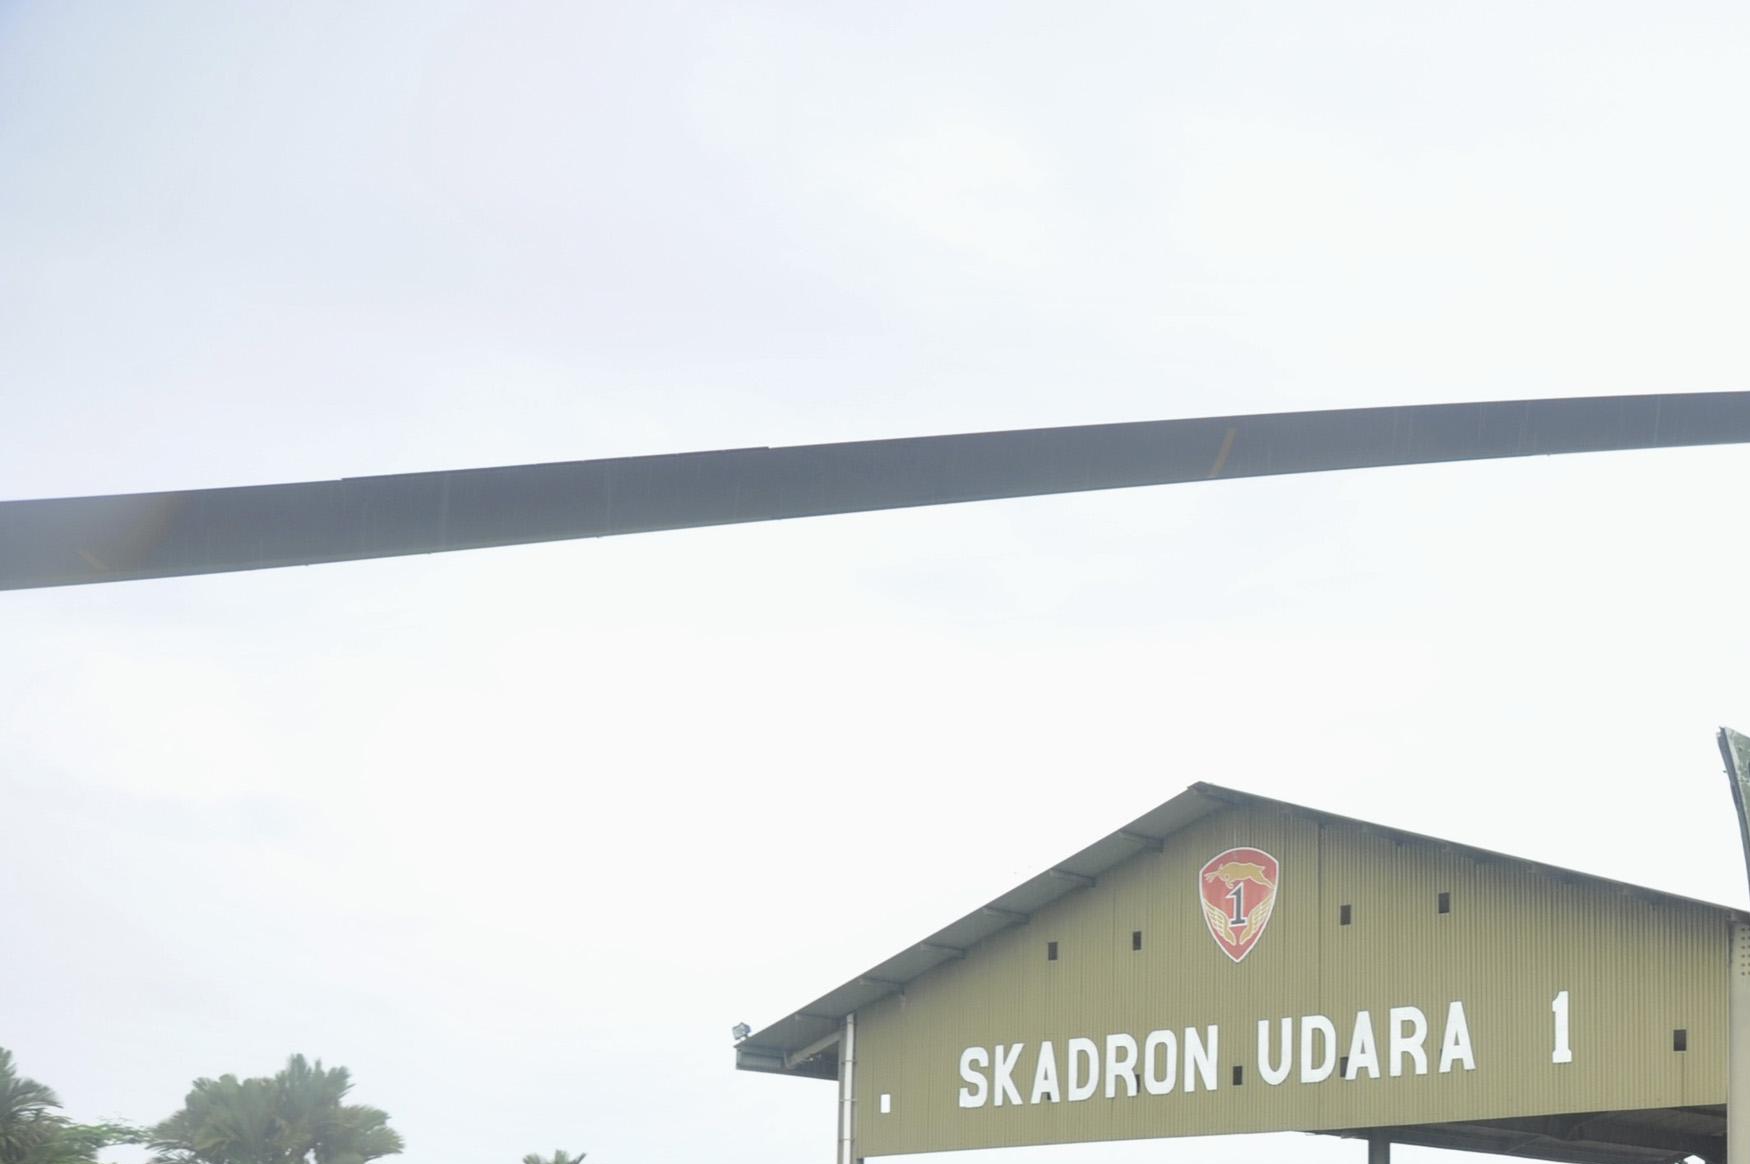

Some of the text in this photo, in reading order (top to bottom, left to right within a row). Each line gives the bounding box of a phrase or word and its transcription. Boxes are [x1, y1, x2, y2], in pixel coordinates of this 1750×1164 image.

[1225, 881, 1248, 927] 1
[958, 990, 1573, 1108] SKADRON UDARA 1
